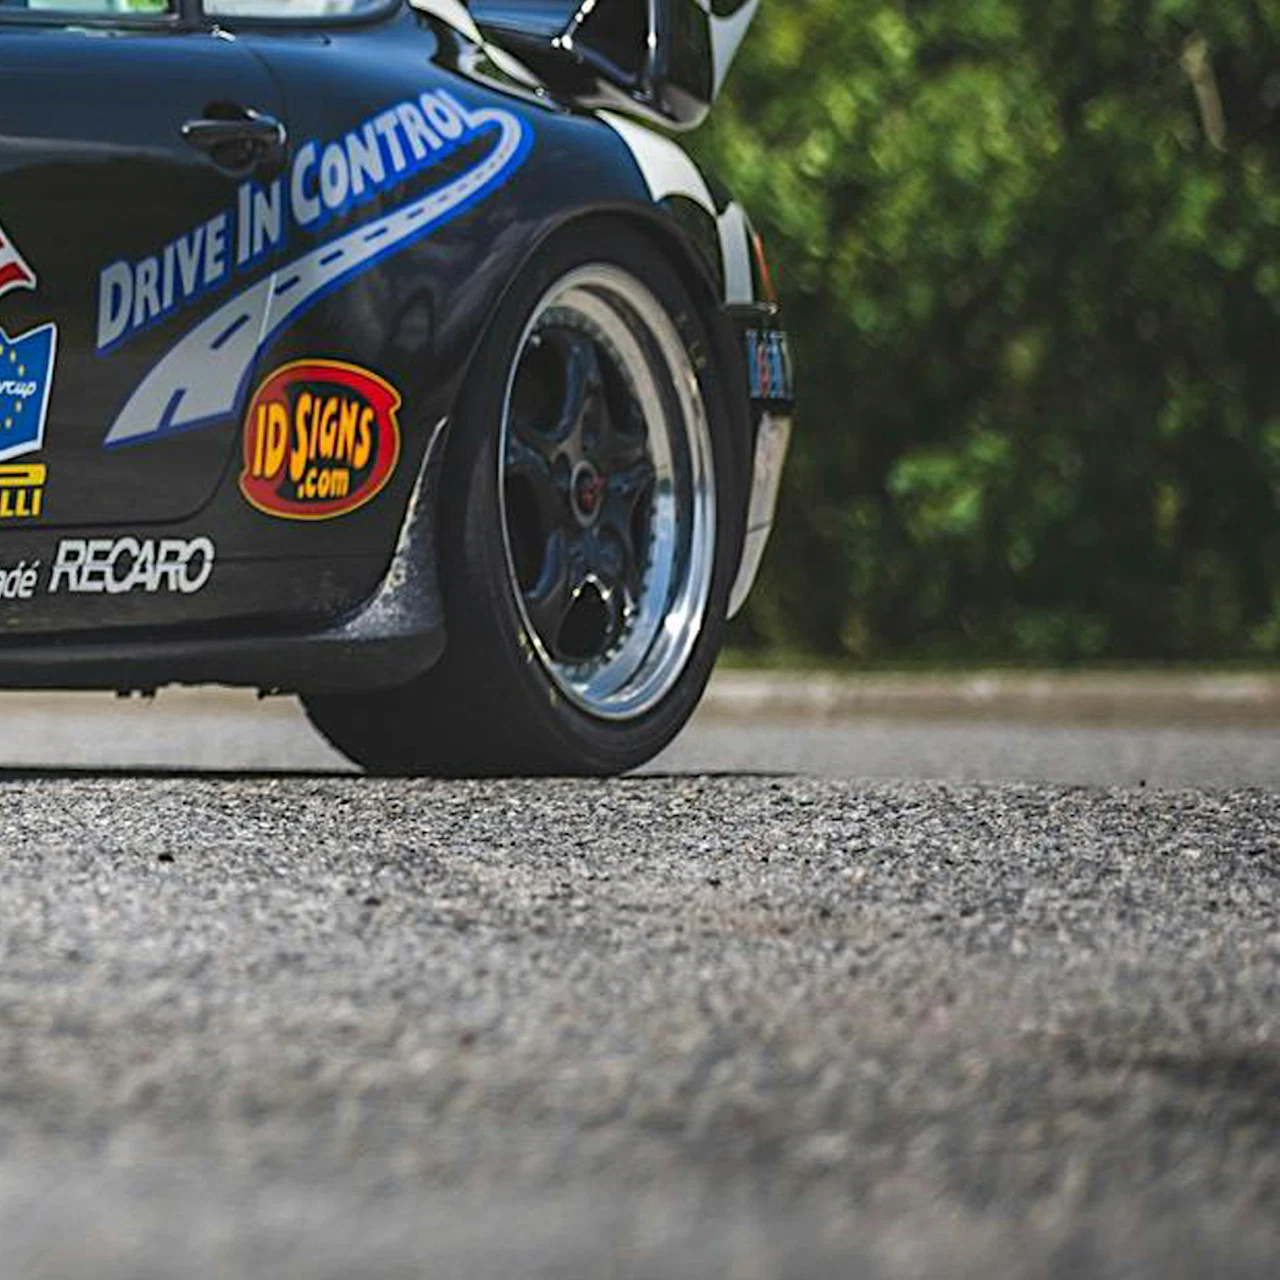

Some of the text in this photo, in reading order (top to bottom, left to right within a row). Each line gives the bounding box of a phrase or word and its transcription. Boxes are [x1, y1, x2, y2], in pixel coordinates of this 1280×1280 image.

[95, 87, 476, 351] DRIVE IN CONTROL
[297, 468, 350, 498] .com
[48, 536, 216, 593] RECARO
